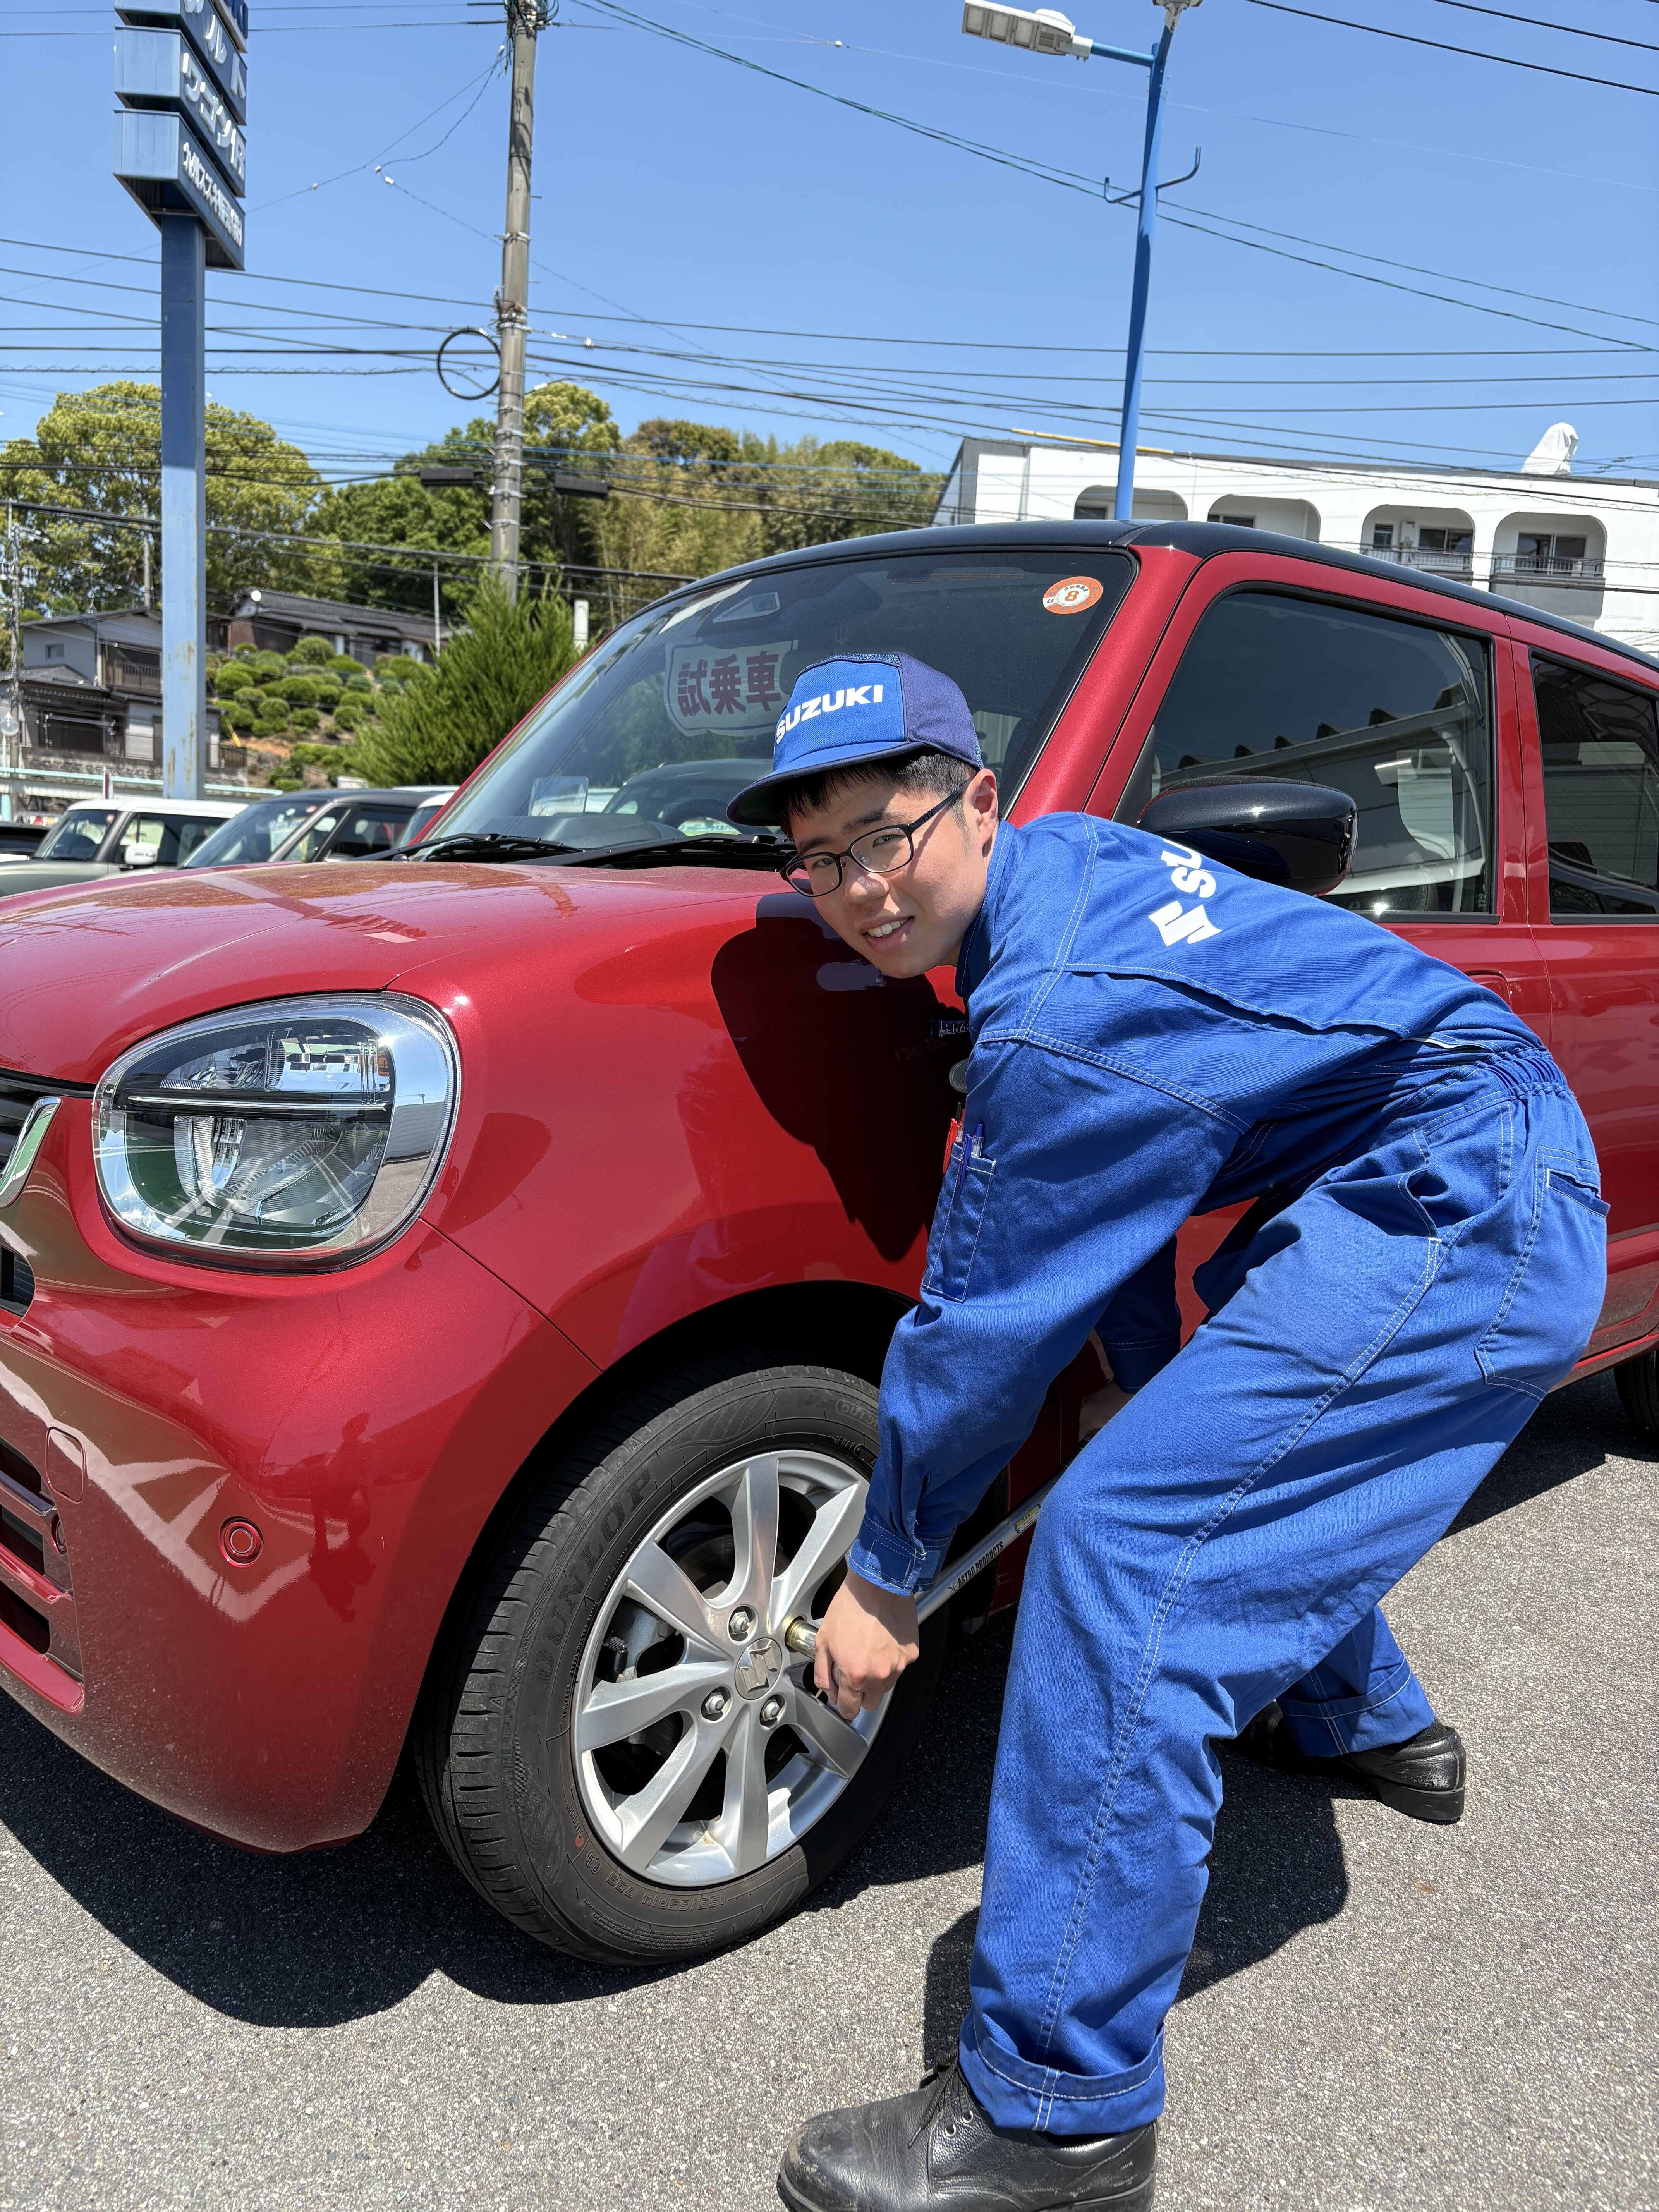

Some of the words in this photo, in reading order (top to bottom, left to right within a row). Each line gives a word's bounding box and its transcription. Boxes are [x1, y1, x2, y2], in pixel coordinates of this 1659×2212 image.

[182, 53, 245, 181] ワゴンR
[678, 651, 782, 717] 試乗車
[776, 685, 883, 744] SUZUKI
[532, 1468, 651, 1691] DUNLOP
[958, 1566, 975, 1588] ASTRO
[975, 1541, 1004, 1572] PRODUCTS
